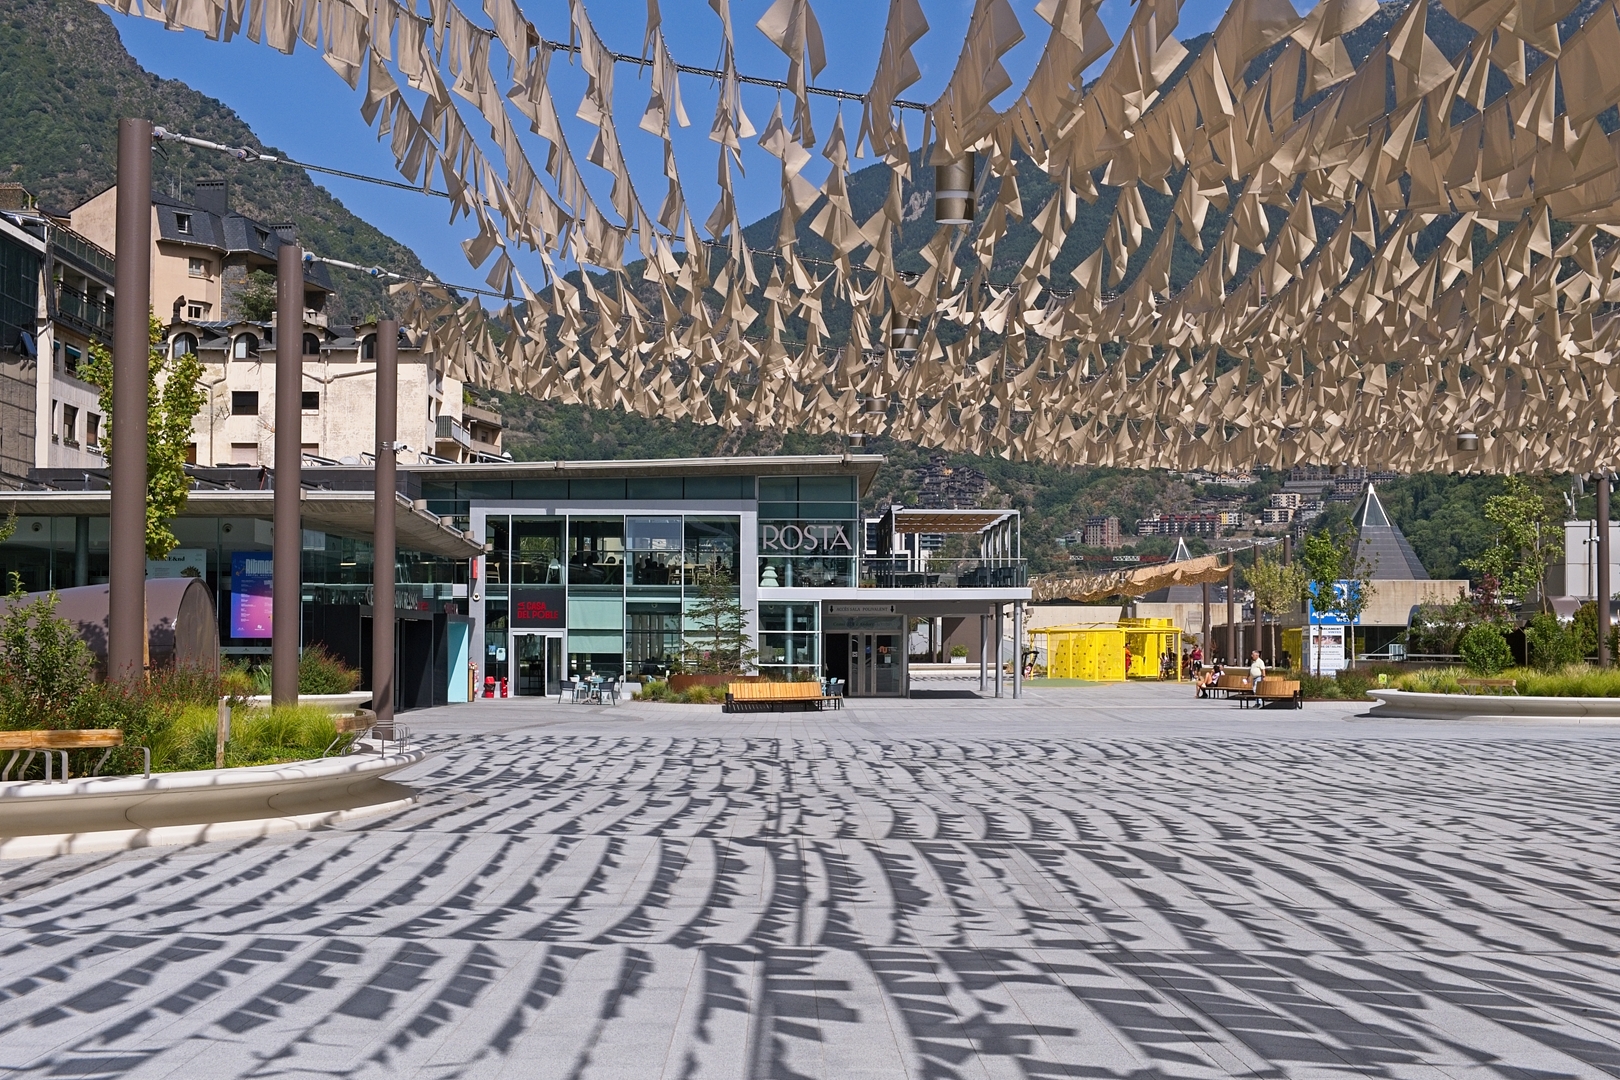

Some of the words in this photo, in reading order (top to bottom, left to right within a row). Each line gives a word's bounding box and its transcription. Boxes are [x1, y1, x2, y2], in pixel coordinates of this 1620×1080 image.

[762, 525, 852, 550] ROSTA
[526, 601, 546, 610] CASA
[517, 611, 530, 619] DEL
[532, 611, 559, 619] POBLE
